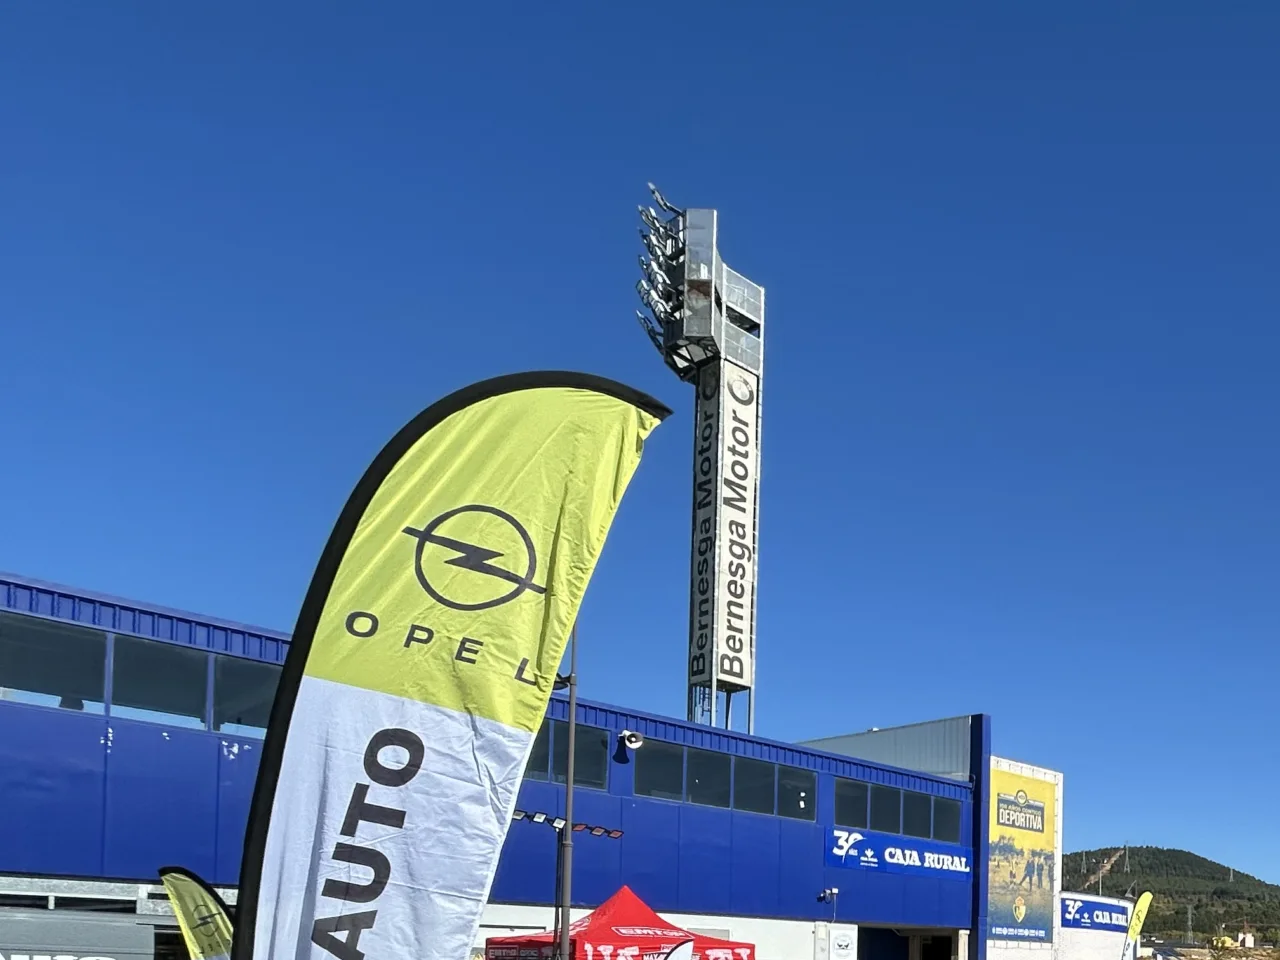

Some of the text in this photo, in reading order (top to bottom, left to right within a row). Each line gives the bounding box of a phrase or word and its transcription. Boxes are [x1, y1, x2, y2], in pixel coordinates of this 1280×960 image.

[691, 410, 714, 678] Bernesga Motor
[719, 408, 751, 680] Bernesga Motor
[345, 610, 541, 688] OPEL
[999, 808, 1043, 830] DEPORTIVA
[884, 847, 970, 872] CAJA RURAL
